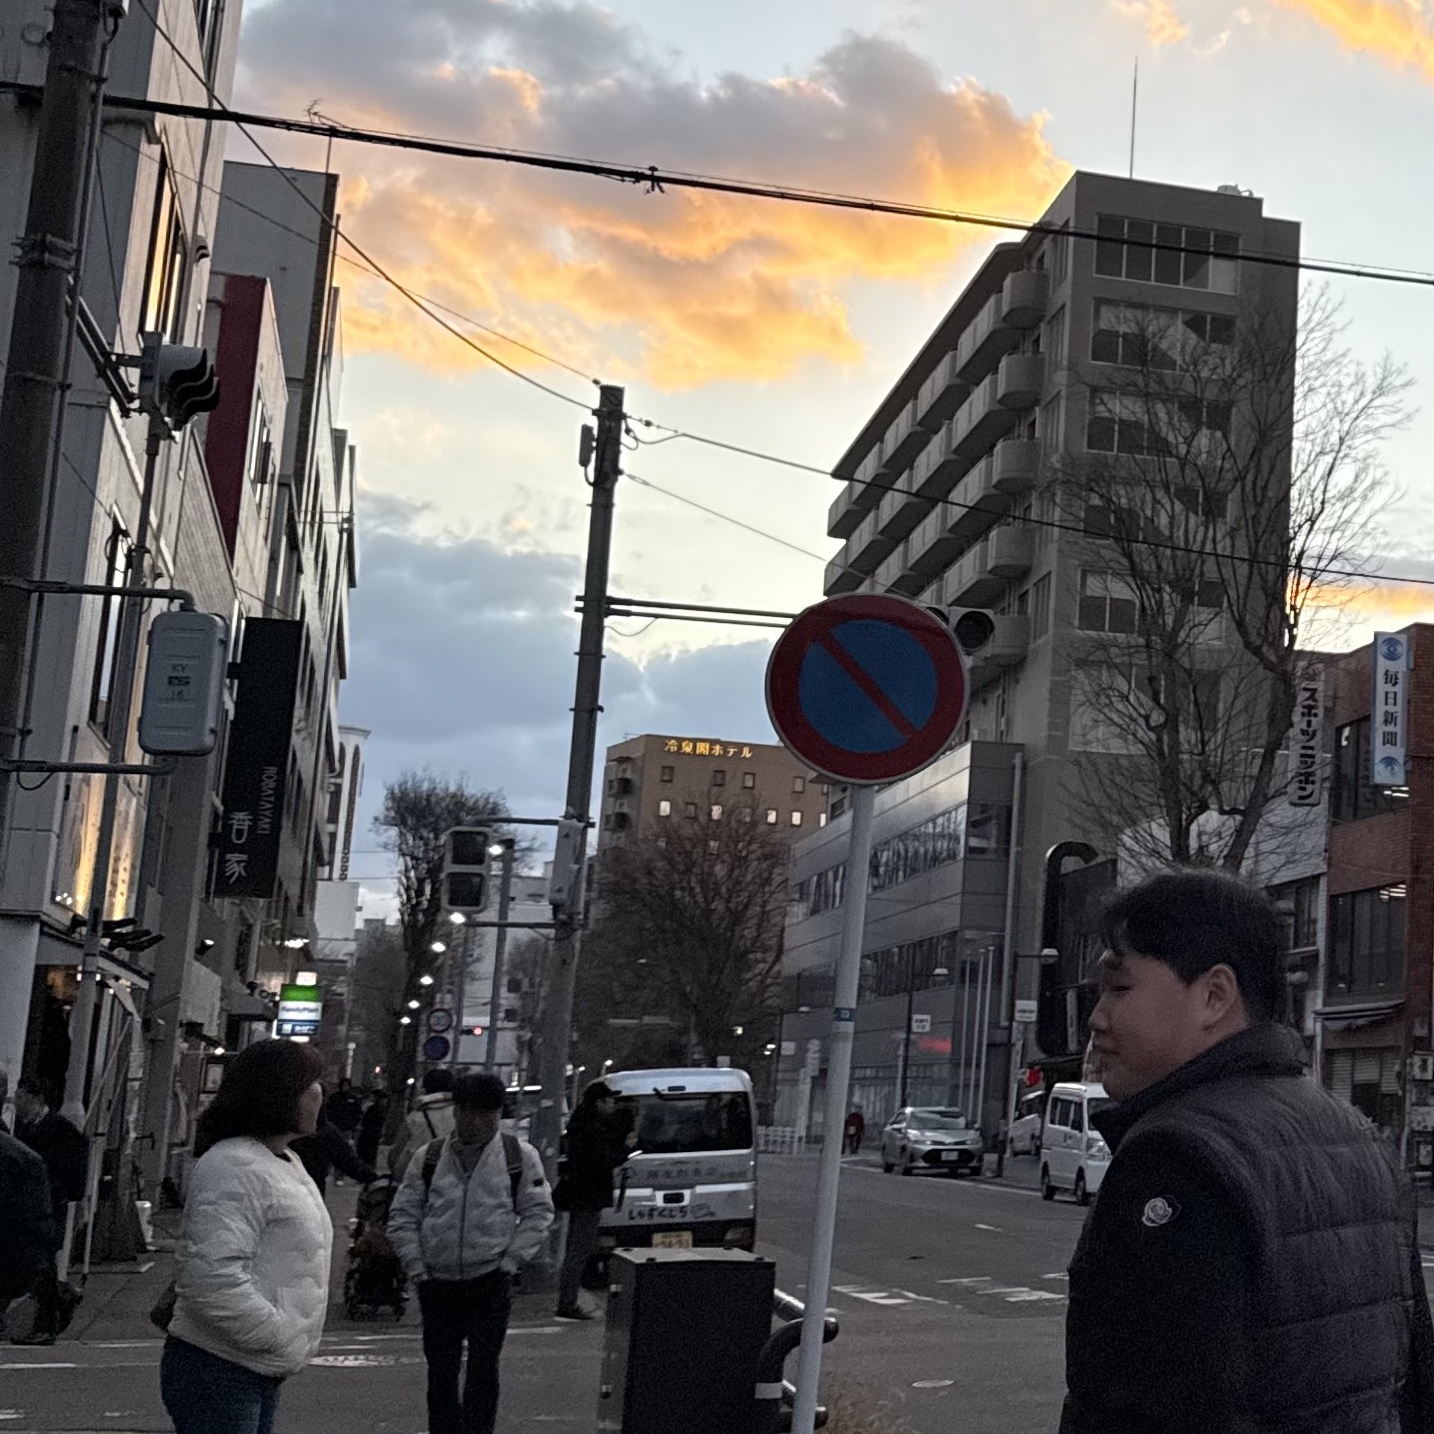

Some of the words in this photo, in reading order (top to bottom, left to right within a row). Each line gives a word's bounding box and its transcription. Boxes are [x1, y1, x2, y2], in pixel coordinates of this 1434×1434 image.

[1298, 686, 1319, 801] スポーツニッポン
[1382, 668, 1400, 747] 毎日新聞
[663, 739, 753, 759] 冷泉閣ホテル
[255, 766, 279, 835] ROBATAYAKI
